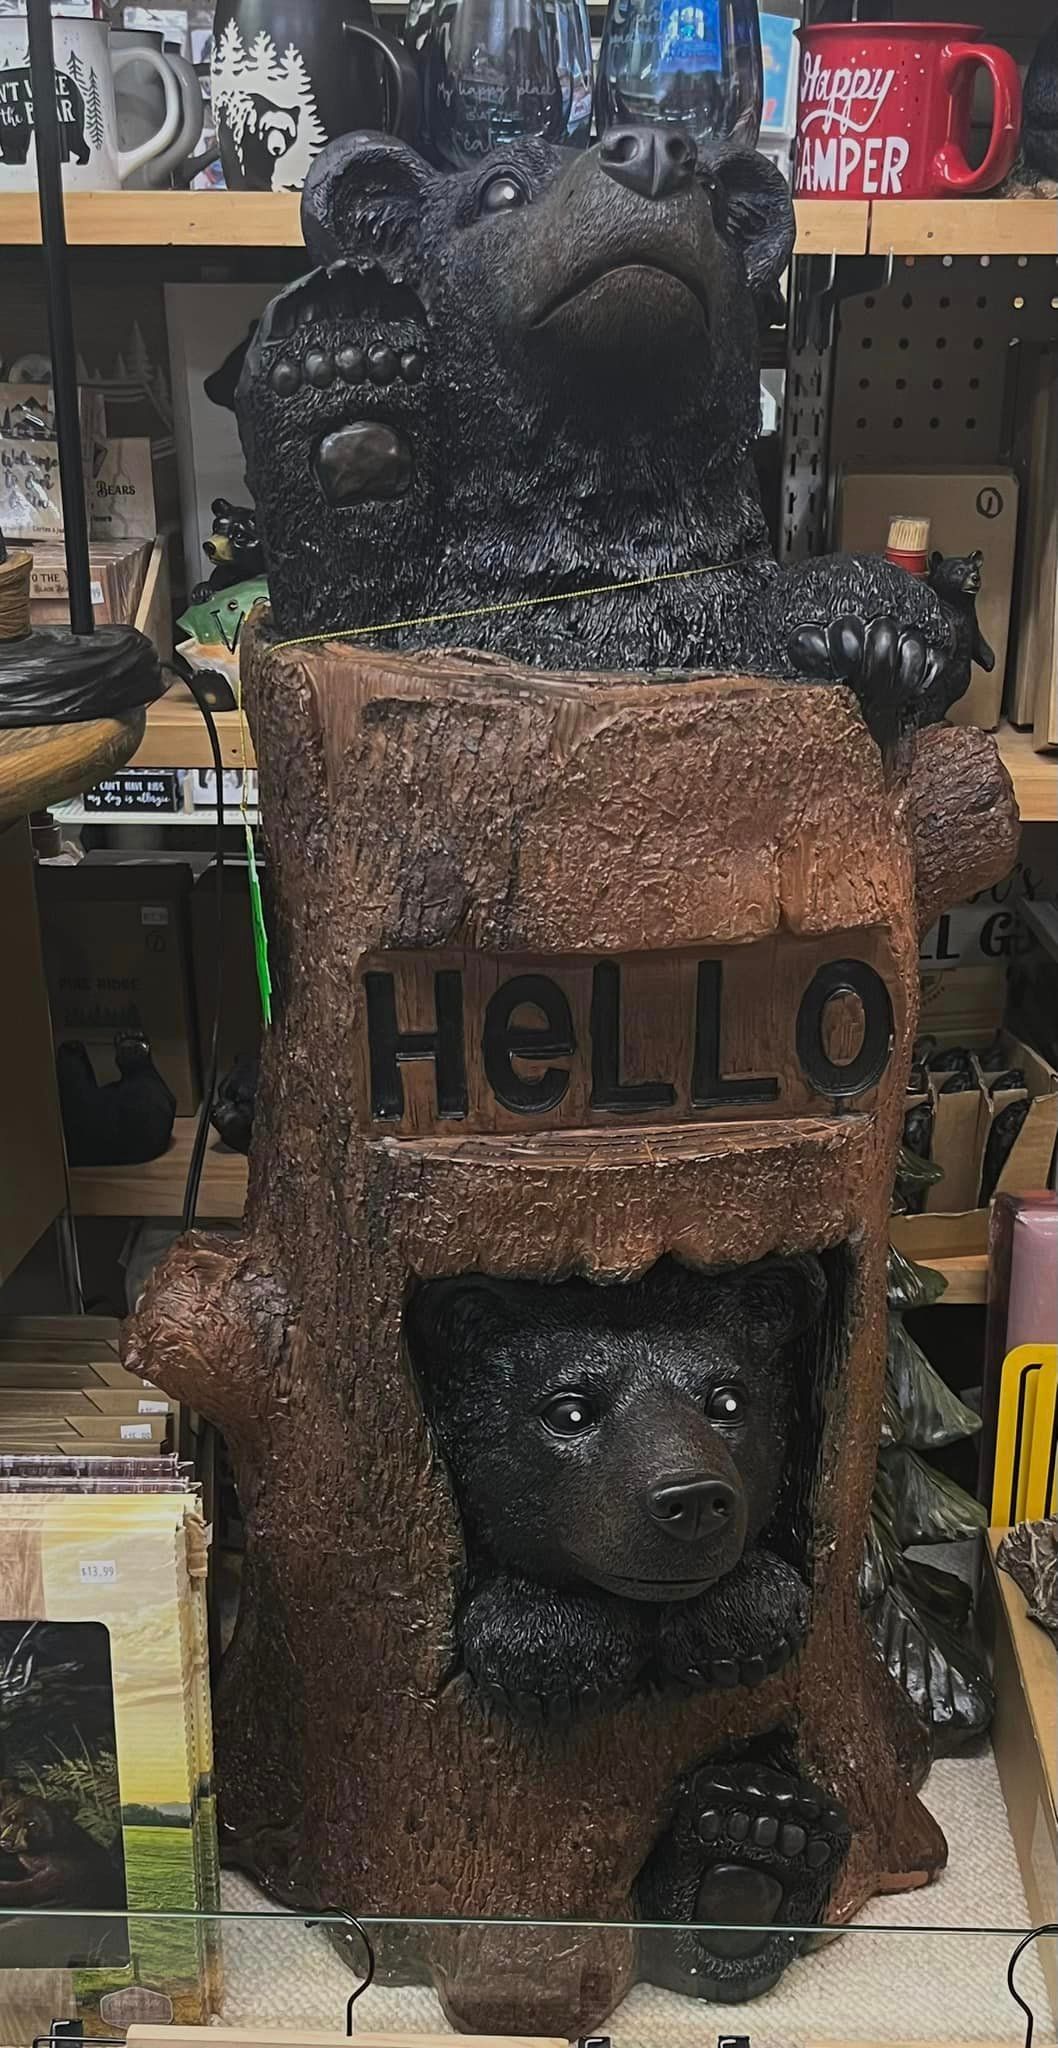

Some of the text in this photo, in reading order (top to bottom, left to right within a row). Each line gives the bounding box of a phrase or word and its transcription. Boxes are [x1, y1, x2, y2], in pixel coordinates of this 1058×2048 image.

[458, 81, 509, 105] happy
[800, 51, 895, 134] Happy
[795, 136, 909, 194] AMPER
[96, 480, 136, 497] BEARS
[40, 573, 60, 583] THE
[87, 794, 101, 806] my
[104, 792, 122, 806] dog
[125, 794, 133, 804] is
[82, 1566, 114, 1577] $13.99
